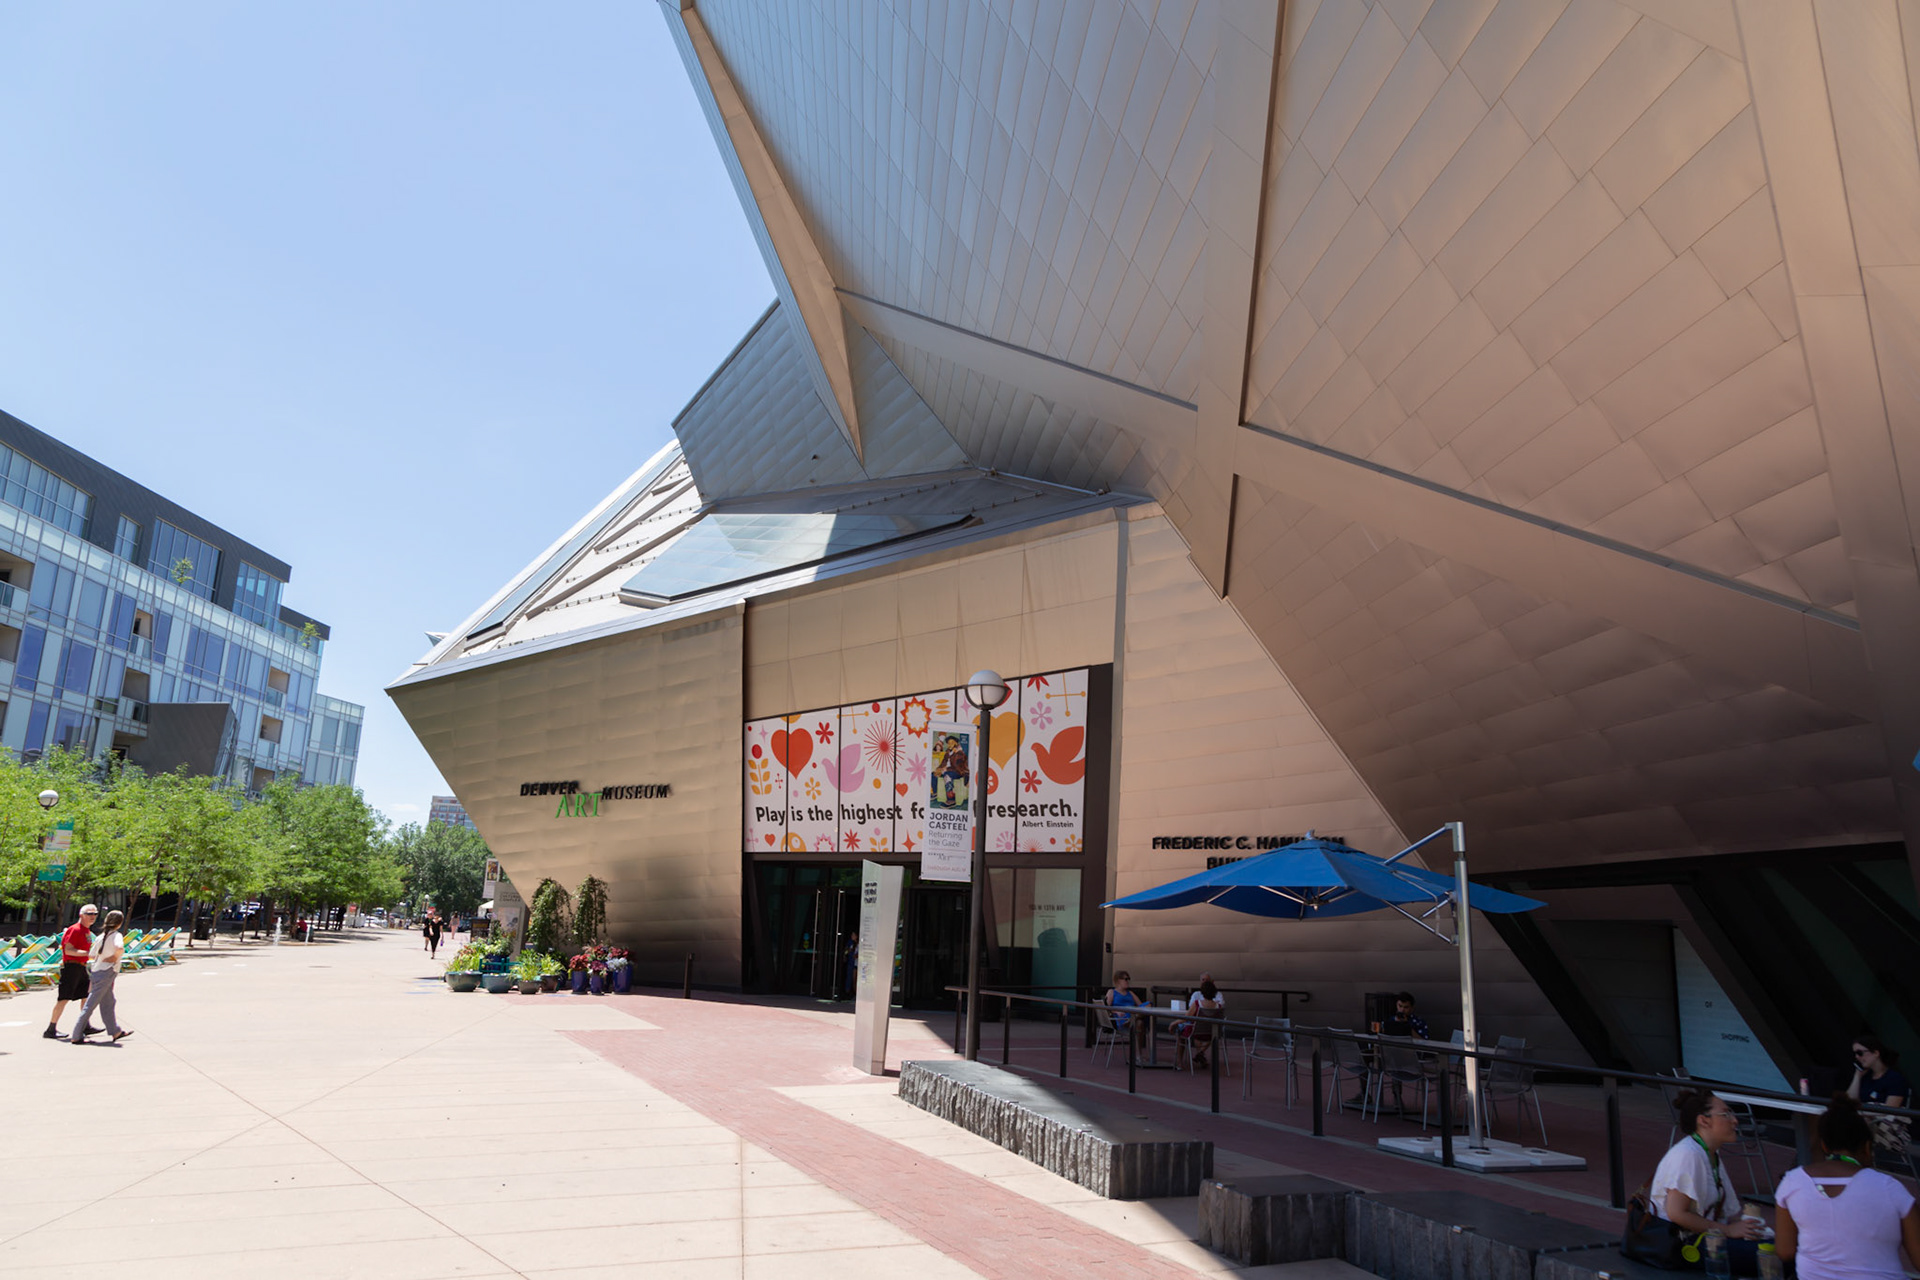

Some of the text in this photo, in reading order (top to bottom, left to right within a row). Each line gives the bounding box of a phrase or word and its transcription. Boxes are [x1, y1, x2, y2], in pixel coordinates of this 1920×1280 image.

[520, 780, 671, 800] DENVER MUSEUM
[555, 793, 603, 818] ART
[755, 806, 786, 826] Play
[791, 806, 804, 821] is
[807, 805, 833, 821] the
[841, 803, 903, 825] highest
[988, 798, 1078, 818] research.
[929, 812, 969, 823] JORDAN
[929, 821, 968, 831] CASTEEL
[1022, 820, 1074, 829] Albert Einstein
[928, 830, 963, 841] Returning
[928, 839, 961, 848] the Gaze
[1152, 836, 1233, 850] FREDERIC
[1235, 836, 1252, 850] C.
